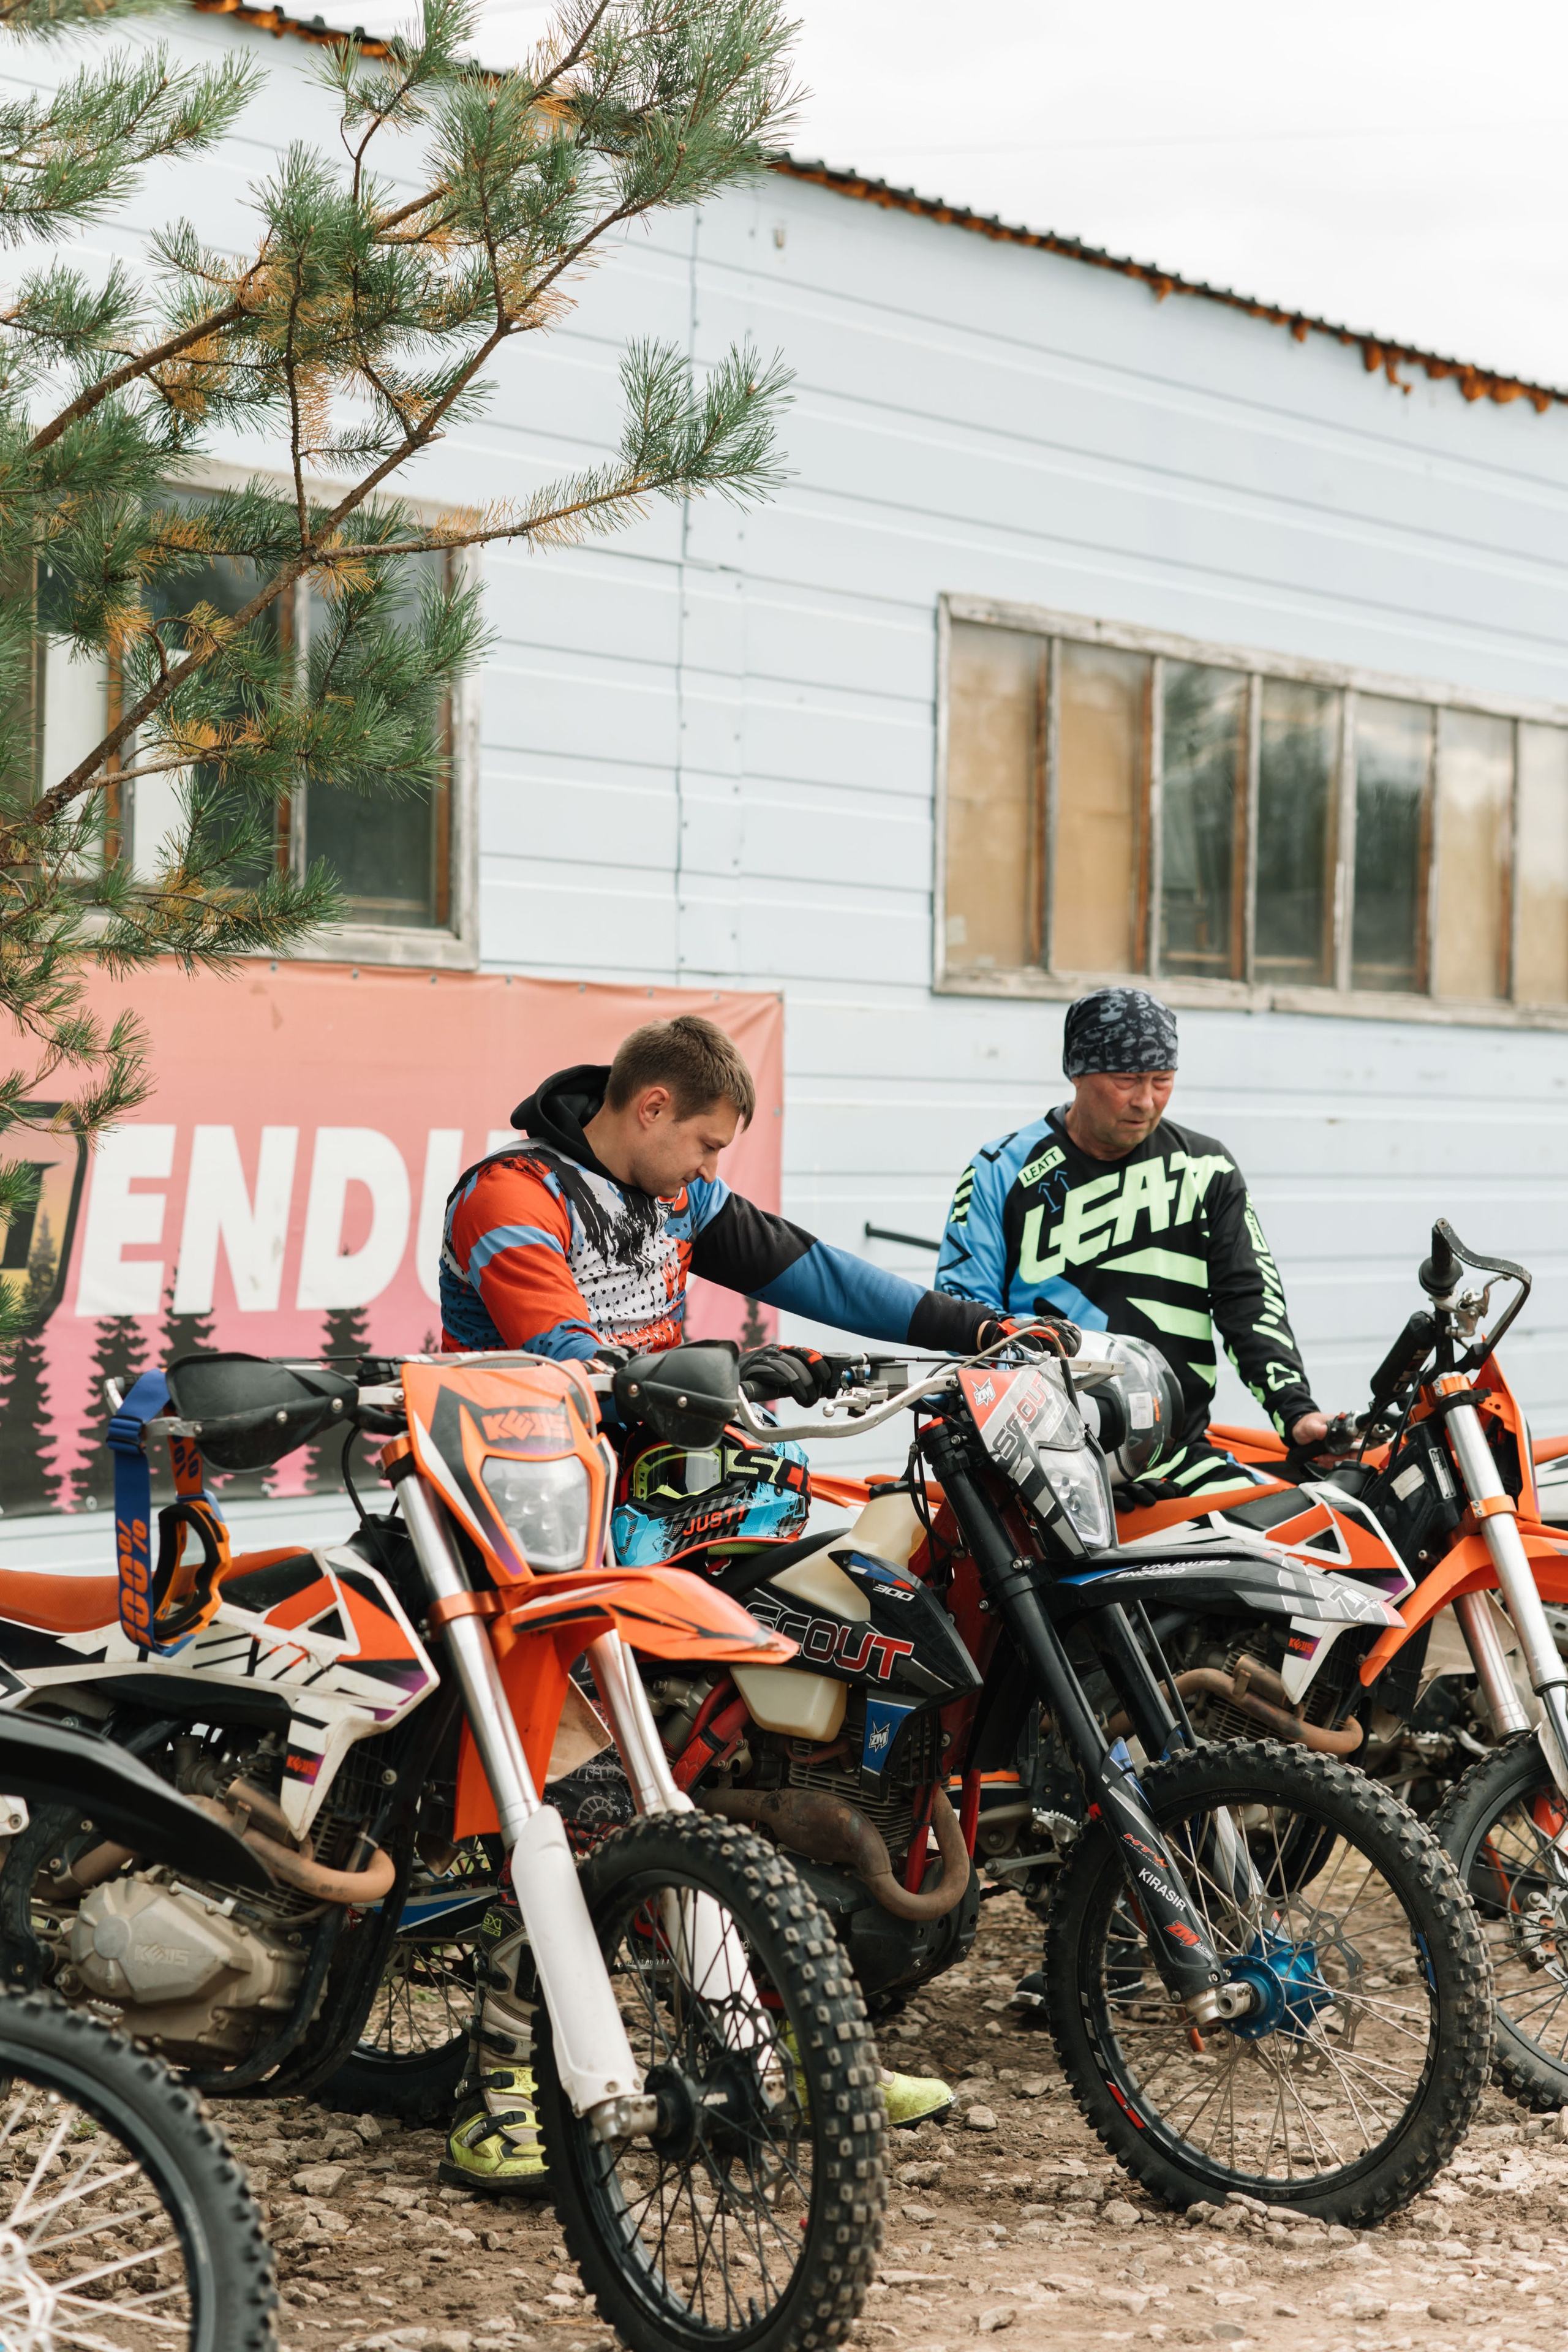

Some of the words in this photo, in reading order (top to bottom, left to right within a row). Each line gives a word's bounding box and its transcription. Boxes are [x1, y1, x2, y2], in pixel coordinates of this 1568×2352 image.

[1023, 1151, 1058, 1182] LEATT
[1019, 1150, 1235, 1285] LEATT
[992, 1370, 1052, 1461] SCOUT
[1044, 1403, 1063, 1434] 300
[682, 1504, 745, 1536] JUST1
[1115, 1568, 1186, 1579] ENDURO
[1141, 1559, 1231, 1570] UNLIMITED
[117, 1518, 153, 1648] 100%
[873, 1584, 915, 1602] 300
[869, 1729, 889, 1749] ZM
[1137, 1868, 1186, 1912] KIRASIR
